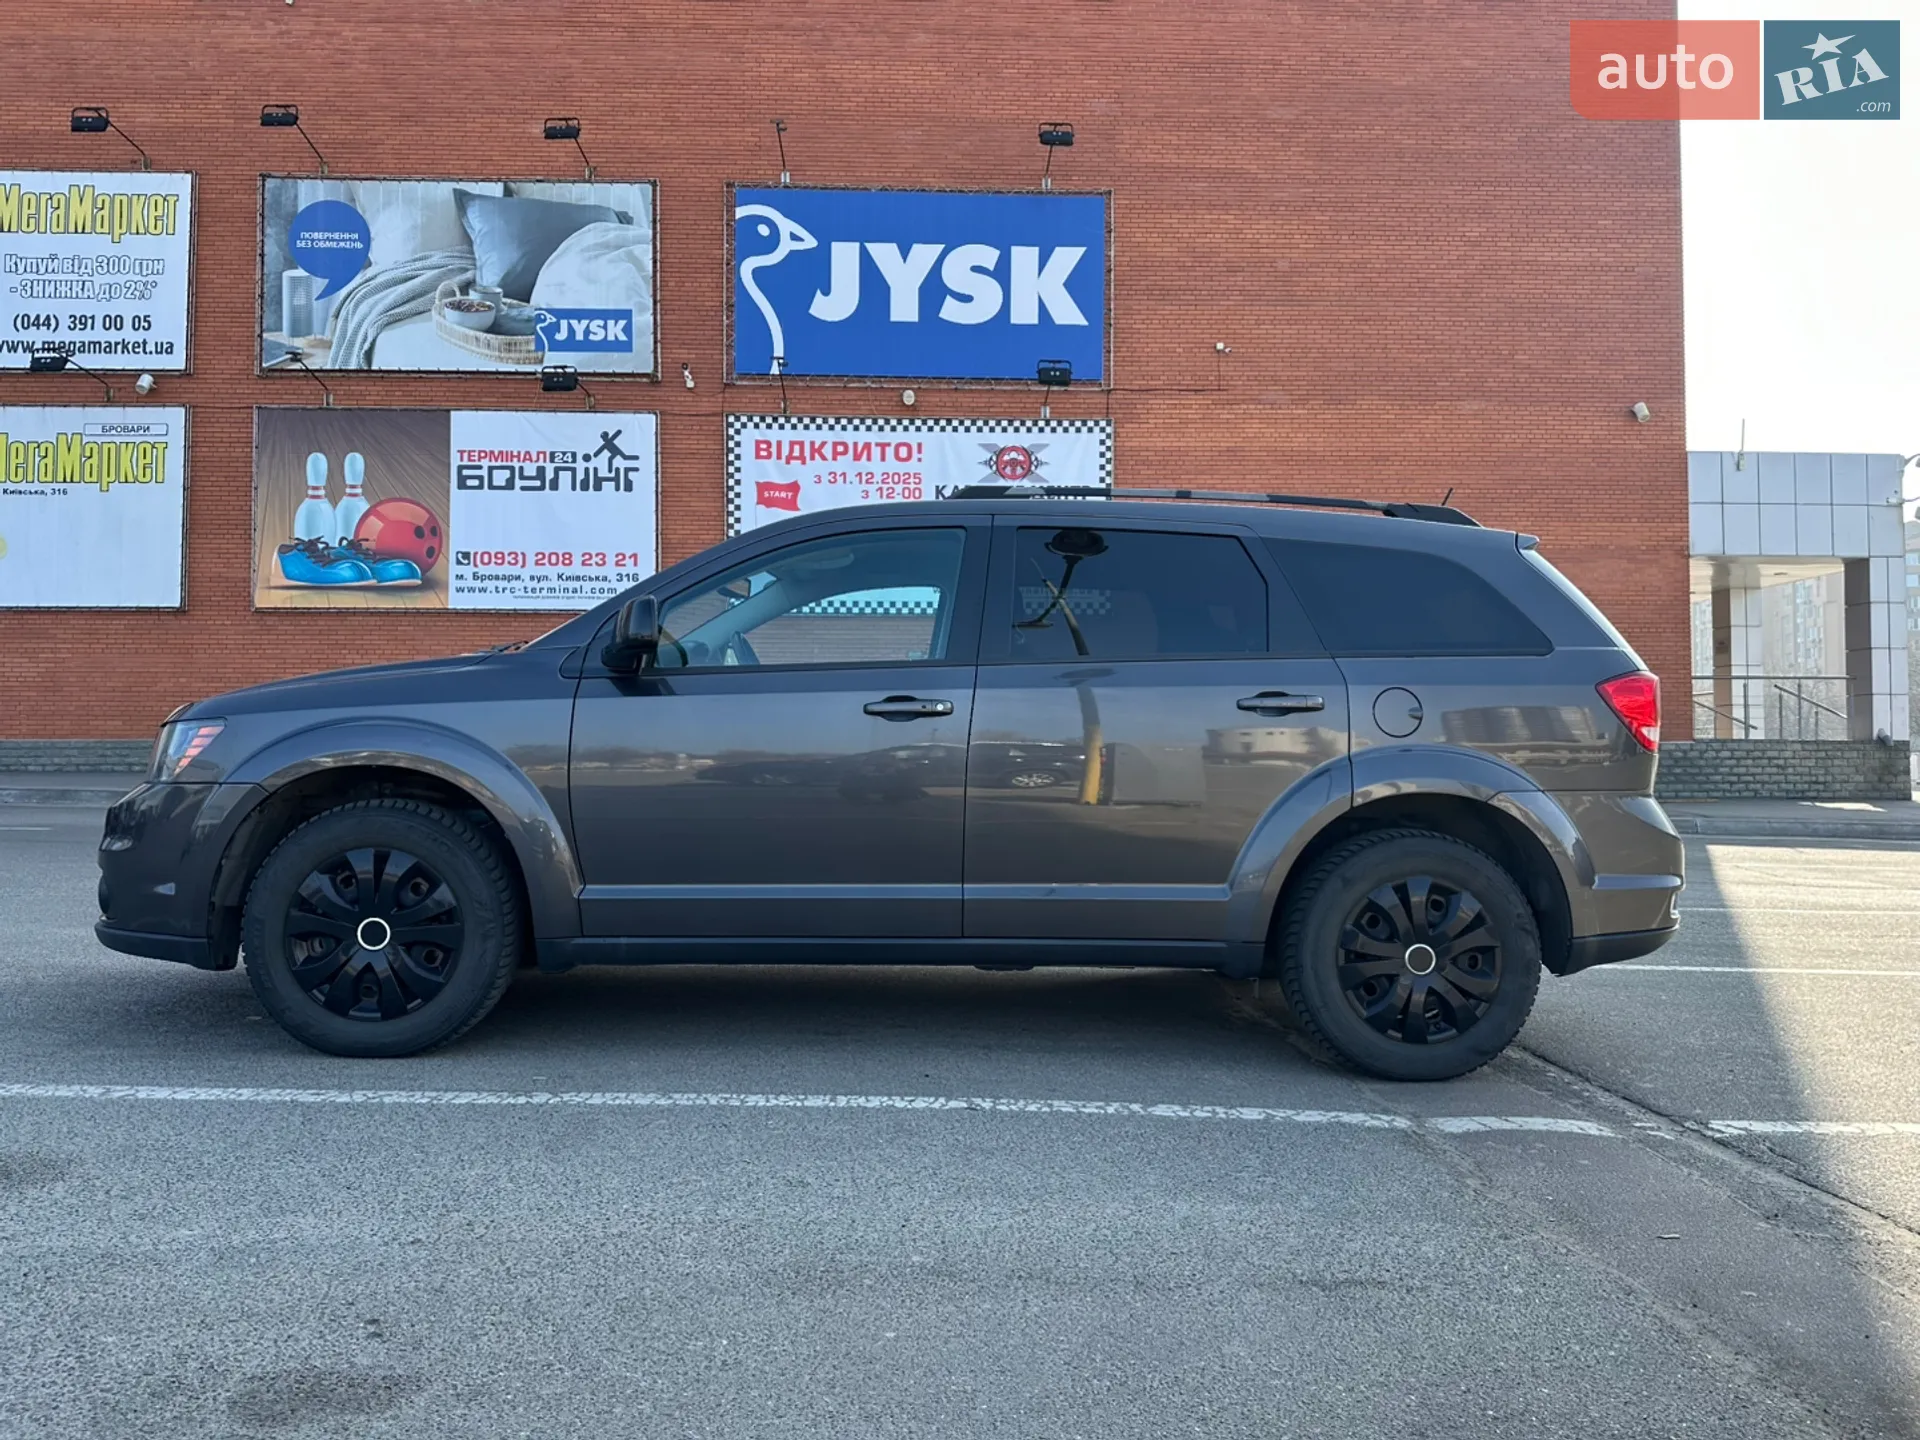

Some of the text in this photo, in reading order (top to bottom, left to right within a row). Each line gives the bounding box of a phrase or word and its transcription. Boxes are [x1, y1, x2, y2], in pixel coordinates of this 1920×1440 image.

[0, 183, 179, 243] МегаМаркет
[296, 240, 364, 249] БЕЗ ОБМЕЖЕНЬ
[300, 232, 359, 240] ПОВЕРНЕННЯ
[4, 254, 165, 276] Купуй від 300 грн
[20, 279, 95, 299] ЗНИЖКА
[97, 283, 122, 302] до
[808, 241, 1089, 326] JYSK
[13, 313, 152, 333] (044) 391 00 05
[554, 319, 628, 342] JYSK
[0, 338, 174, 357] ww.megamarket.ua
[101, 424, 150, 434] БРОВАРИ
[457, 450, 574, 463] ТЕРМІНАЛ 24
[754, 439, 923, 465] ВІДКРИТО!
[457, 464, 640, 492] БОУЛІНГ
[828, 472, 922, 485] 31.12.2025
[2, 488, 68, 496] Київська, 316
[763, 491, 793, 500] START
[876, 487, 922, 500] 12-00
[473, 551, 639, 568] (093) 208 23 21
[472, 572, 525, 584] Бровари,
[529, 574, 552, 584] вул.
[557, 573, 611, 584] Київська,
[616, 573, 640, 582] 316
